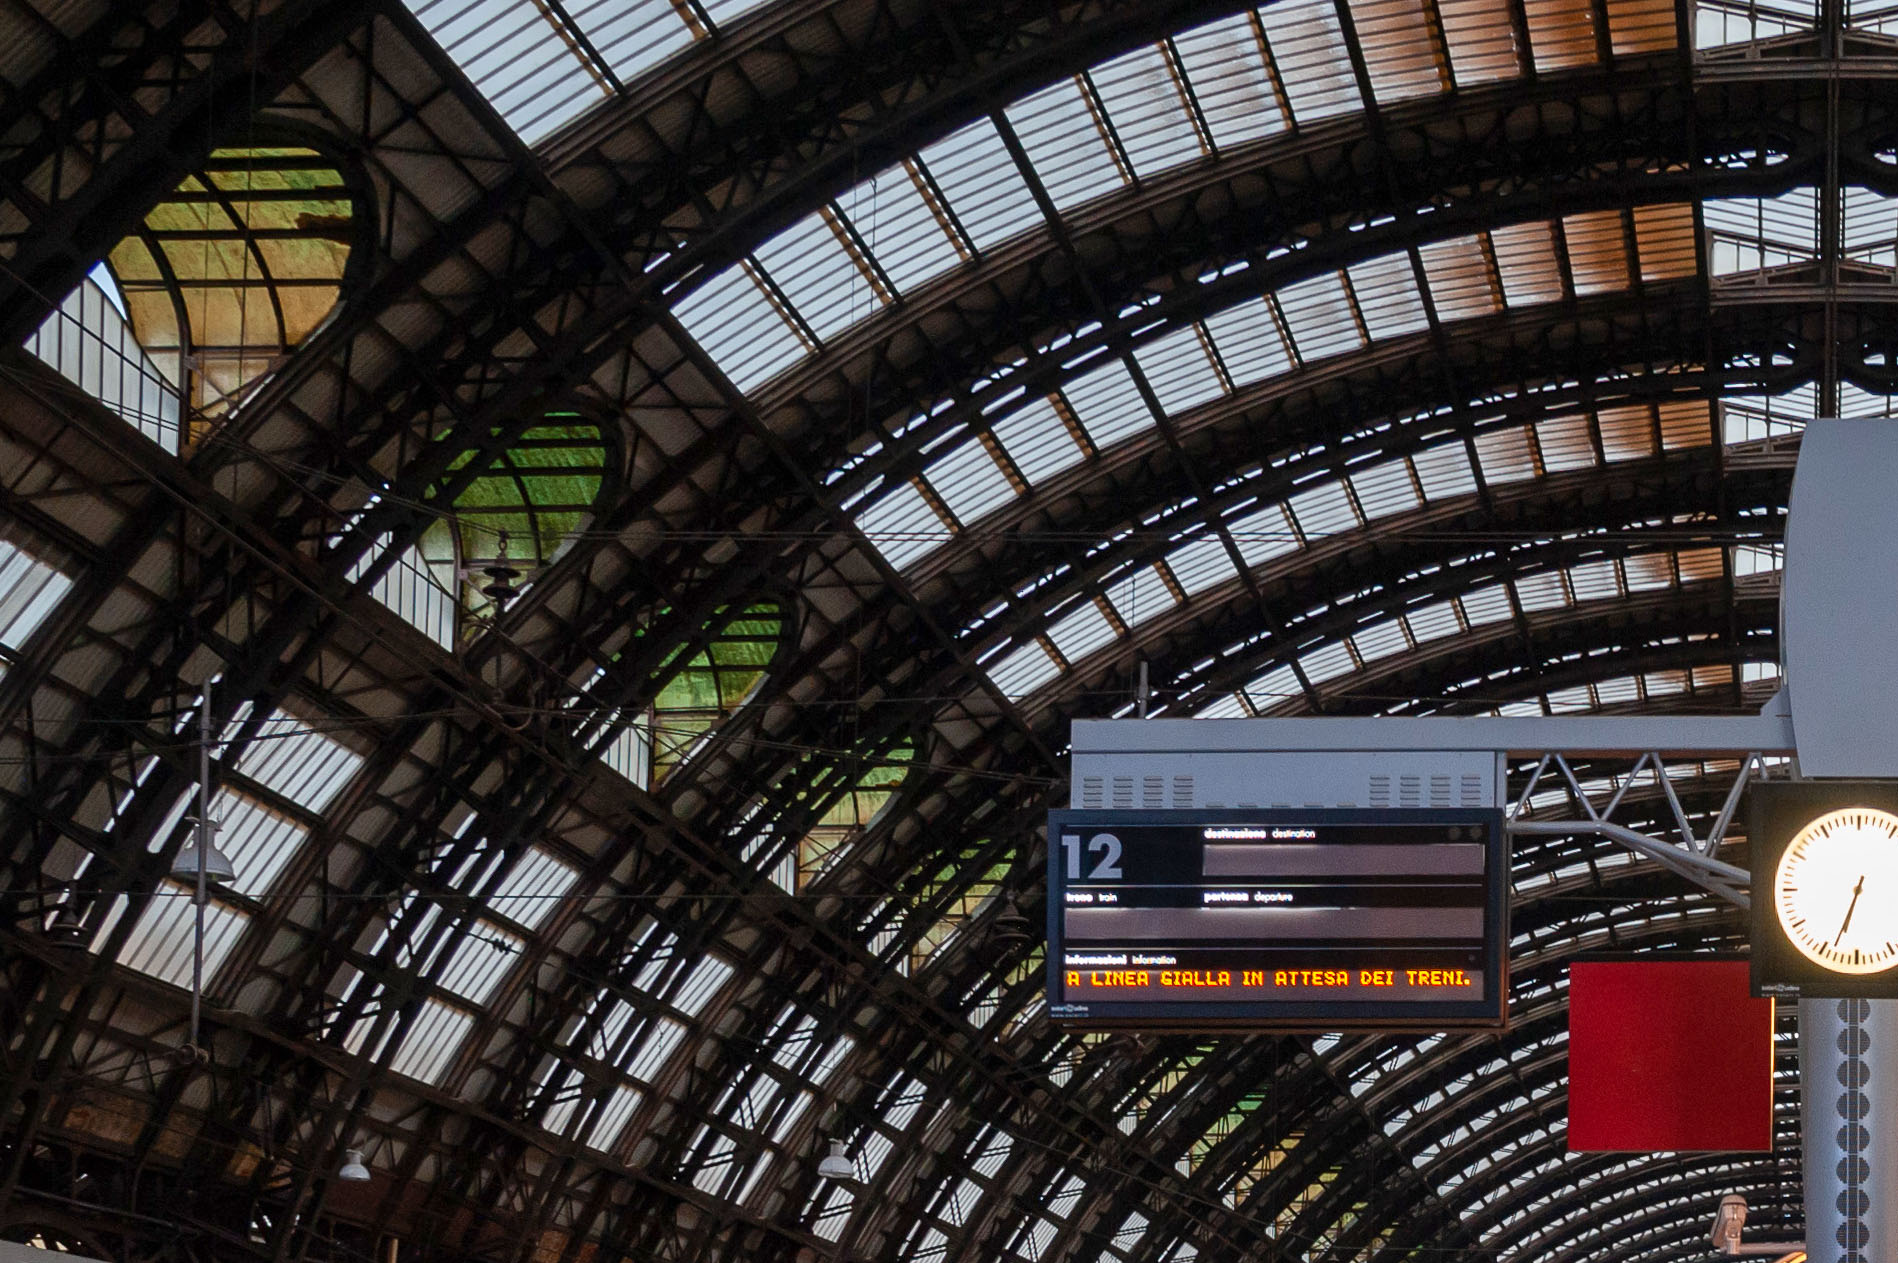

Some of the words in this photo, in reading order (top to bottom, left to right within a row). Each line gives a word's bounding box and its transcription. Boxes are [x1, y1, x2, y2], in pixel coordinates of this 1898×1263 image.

[1272, 828, 1315, 839] destination
[1061, 833, 1123, 879] 12
[1099, 892, 1117, 902] train
[1254, 891, 1293, 903] departure
[1132, 954, 1176, 965] information
[1066, 970, 1080, 987] A
[1091, 970, 1149, 987] LINEA
[1160, 970, 1231, 987] GIALLA
[1242, 970, 1264, 987] IN
[1275, 970, 1349, 987] ATTESA
[1360, 969, 1394, 986] DEI
[1406, 969, 1471, 986] TRENI.
